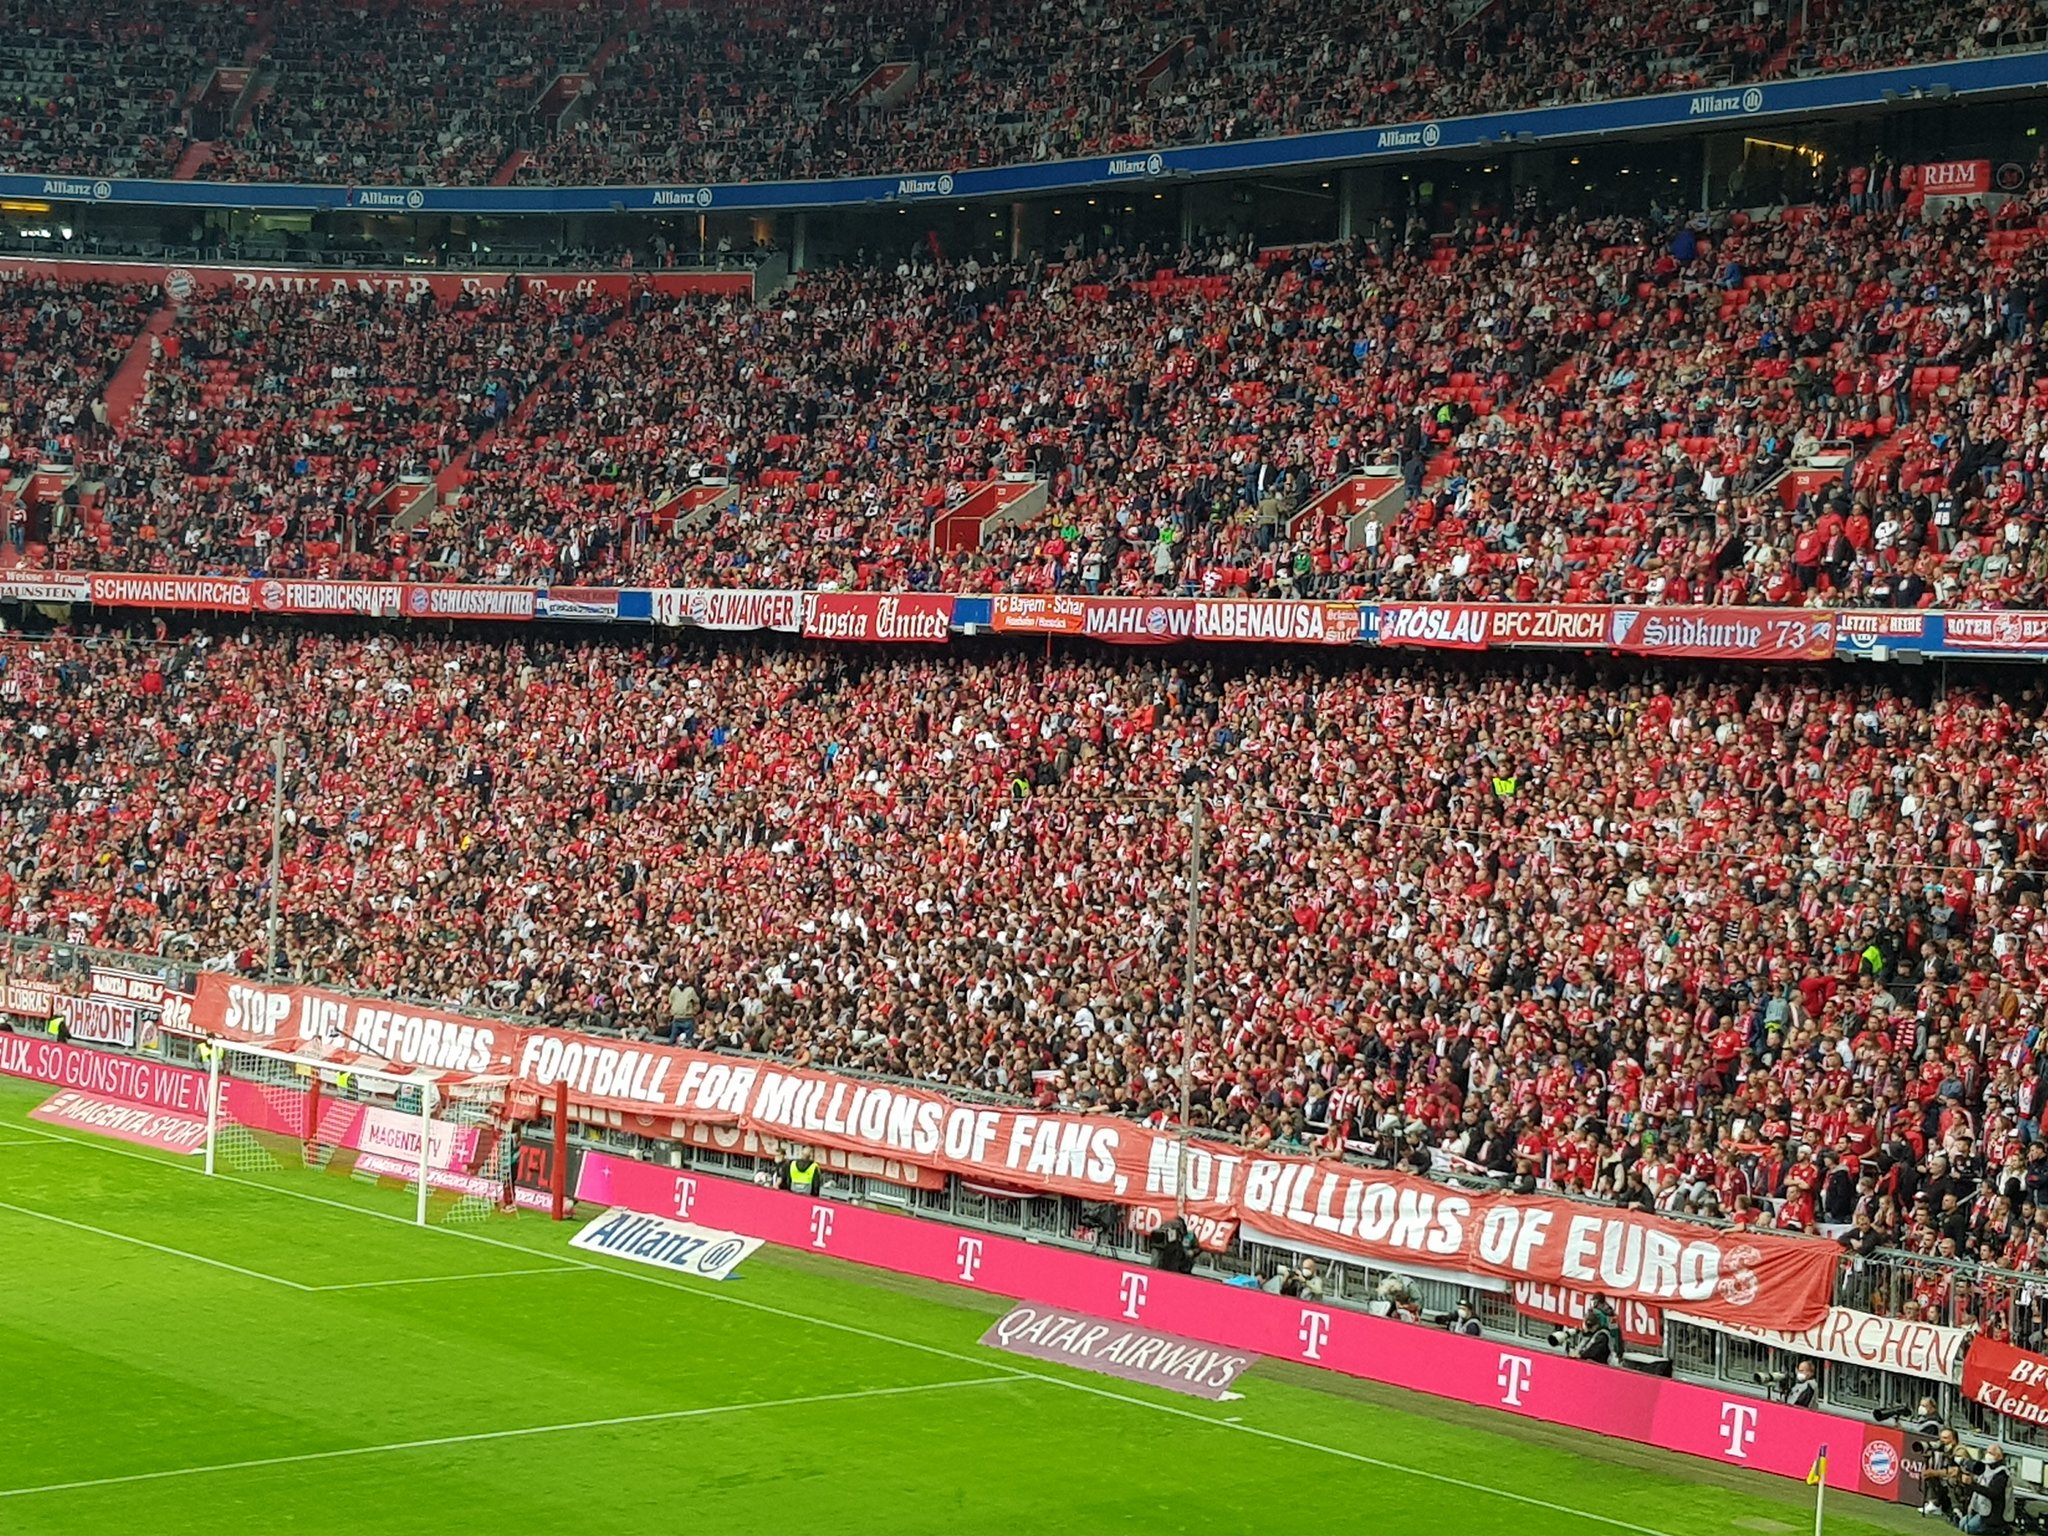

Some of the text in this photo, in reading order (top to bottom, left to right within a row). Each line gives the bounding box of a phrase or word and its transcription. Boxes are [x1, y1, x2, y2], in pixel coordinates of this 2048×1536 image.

[1689, 95, 1740, 115] Allianz
[1377, 131, 1421, 148] Allianz
[1108, 159, 1146, 175] Allianz
[1924, 163, 1976, 186] RHM
[43, 181, 91, 195] Allianz
[359, 191, 405, 205] Allianz
[652, 191, 695, 204] Allianz
[898, 180, 936, 195] Allianz
[95, 578, 250, 605] SCHWANENKIRCHEN
[286, 583, 402, 611] FRIEDRICHSHAFEN
[431, 588, 533, 616] SCHLOSSPANTHER
[657, 593, 672, 624] 13
[803, 594, 949, 639] Lipsia United
[993, 596, 1009, 614] FC
[1009, 596, 1045, 616] Bayern
[1393, 606, 1488, 643] RÖSLAU
[1493, 610, 1606, 639] BFC ZÜRICH
[1643, 615, 1807, 649] Südkurve '73
[1841, 614, 1877, 632] LETZTE
[8, 986, 50, 1014] COBRAS
[0, 1036, 231, 1117] LIX. SO GÜNSTIG WIE NE
[224, 984, 291, 1036] STOP
[351, 1007, 495, 1073] REFORMS
[519, 1035, 672, 1104] FOOTBALL
[674, 1061, 758, 1115] FOR
[752, 1072, 943, 1155] MILLIONS
[944, 1108, 1001, 1162] OF
[1005, 1114, 1129, 1196] FANS,
[1146, 1136, 1241, 1204] NOT
[1243, 1159, 1471, 1255] BILLIONS
[1478, 1205, 1553, 1272] OF
[584, 1213, 708, 1266] Allianz
[997, 1308, 1246, 1388] QATAR AIRWAYS
[2007, 1359, 2048, 1391] BF
